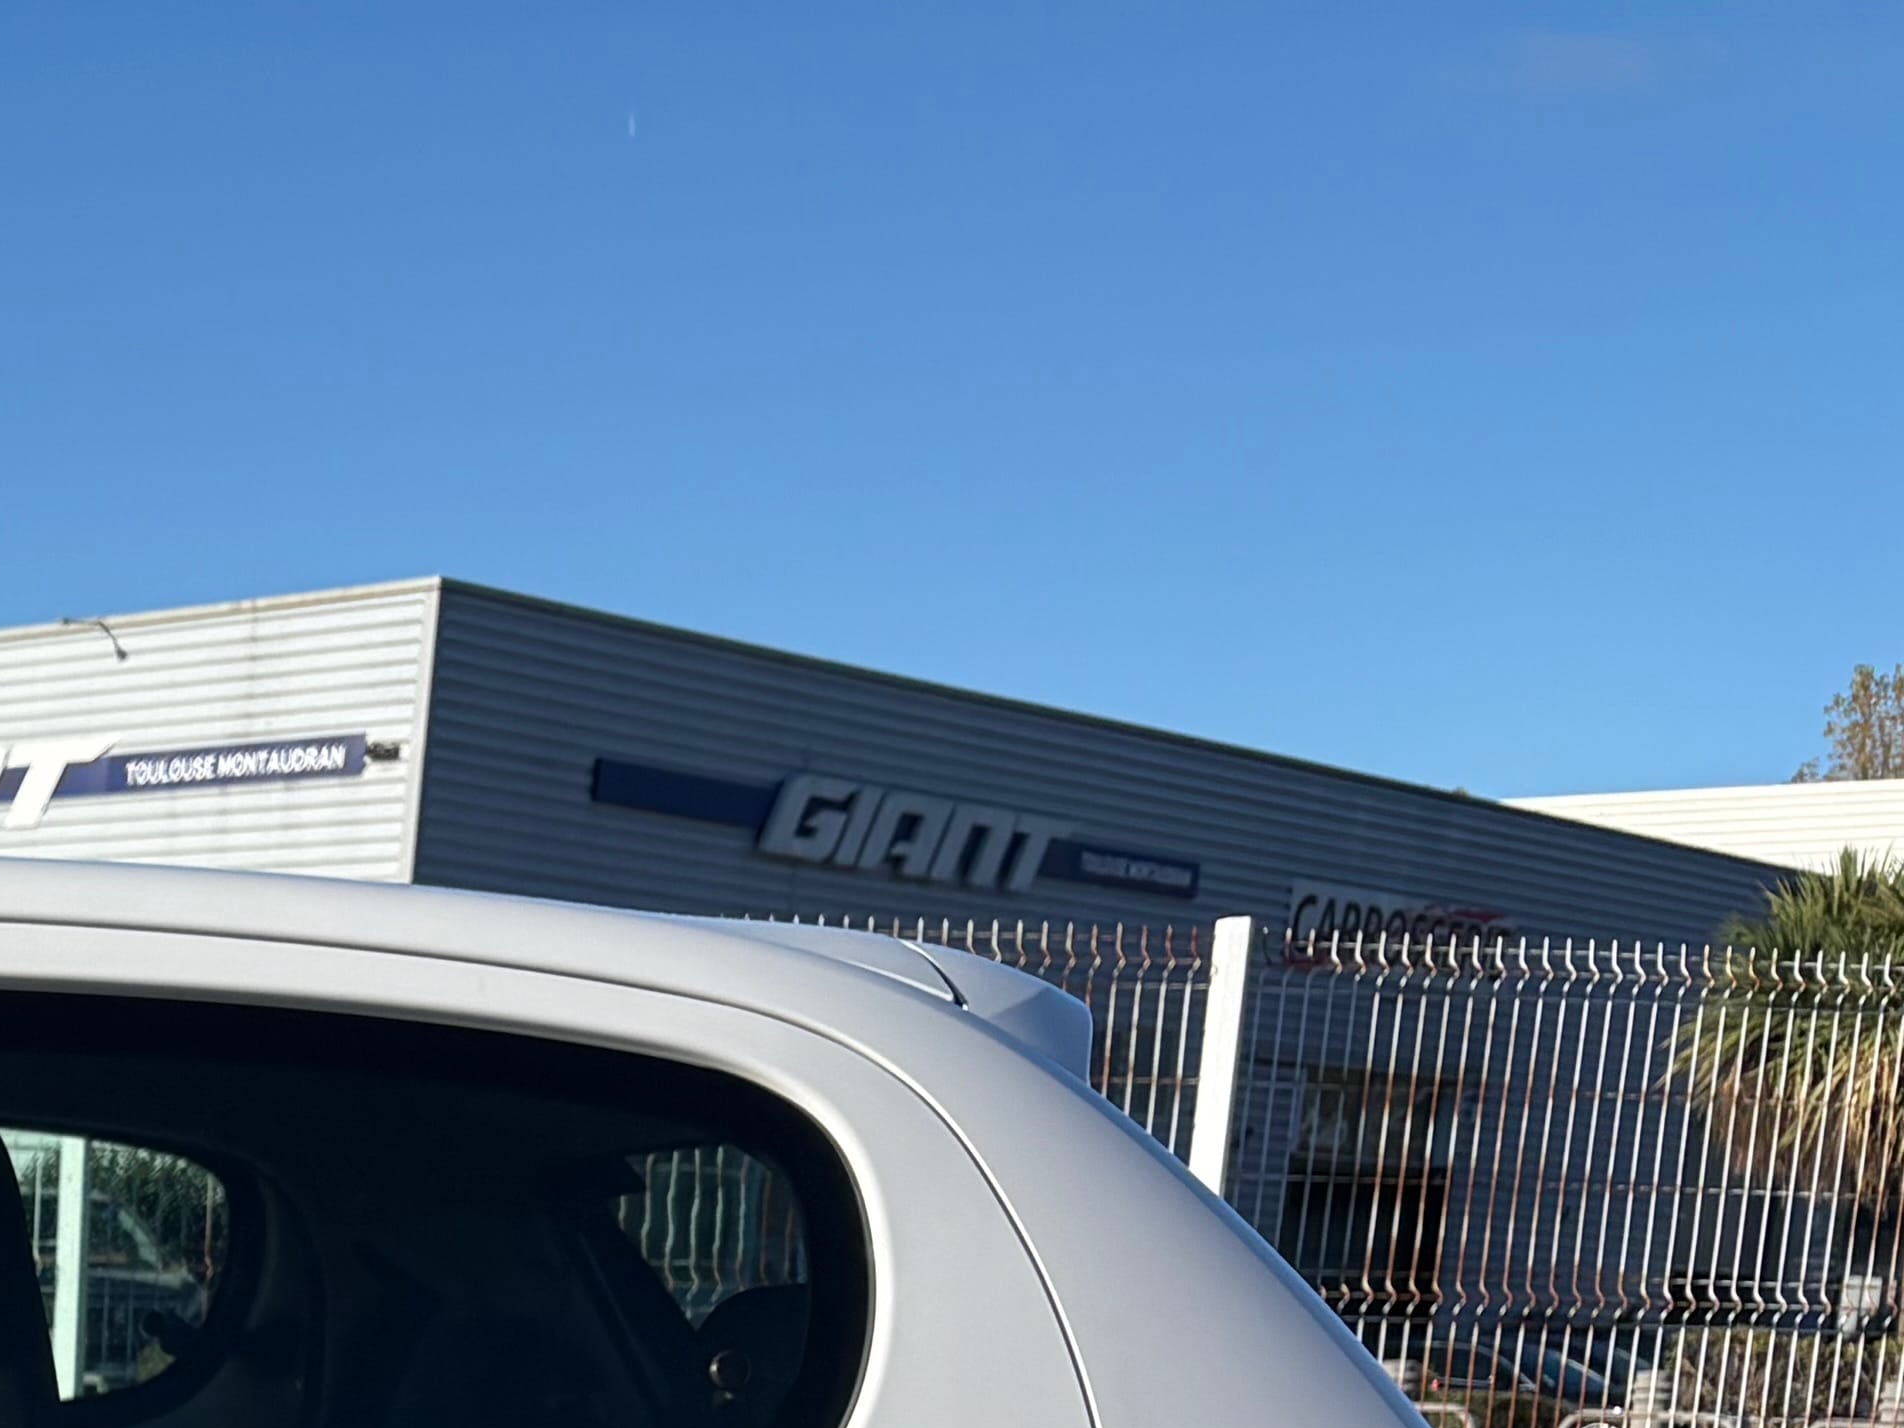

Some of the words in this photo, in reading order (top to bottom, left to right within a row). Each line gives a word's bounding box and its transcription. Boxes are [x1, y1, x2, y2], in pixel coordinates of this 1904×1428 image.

[125, 754, 215, 786] TOULOUSE
[217, 741, 347, 777] MONTAUDRAN
[757, 772, 1079, 894] GIANT
